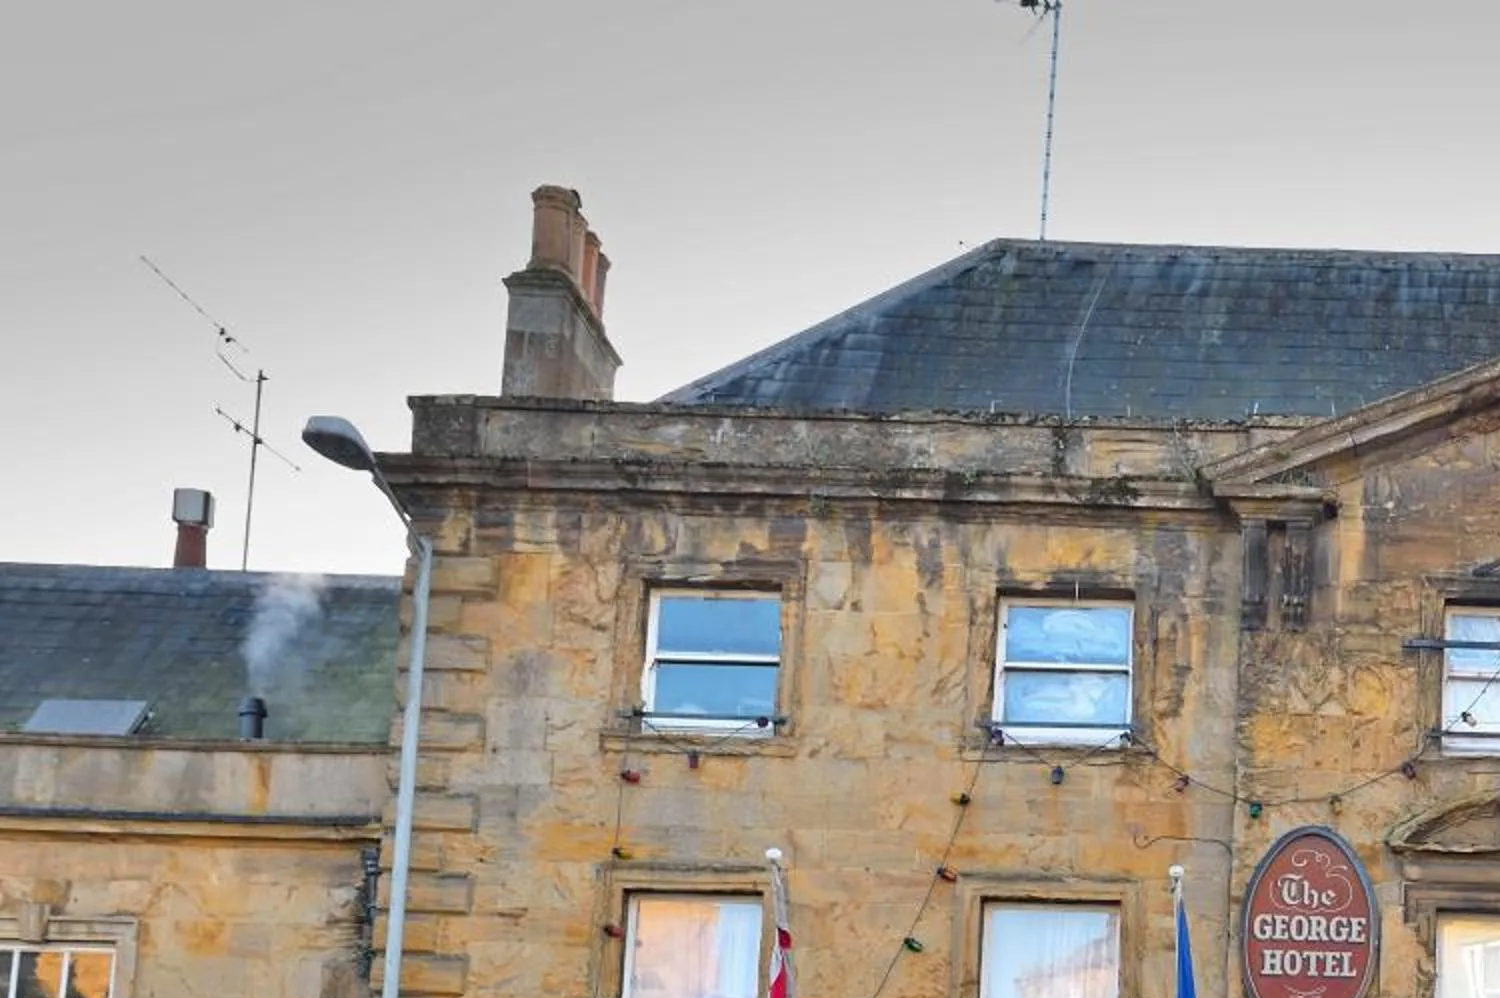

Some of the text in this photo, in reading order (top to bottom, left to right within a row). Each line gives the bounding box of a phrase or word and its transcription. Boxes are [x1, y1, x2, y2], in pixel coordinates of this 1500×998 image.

[1277, 873, 1336, 909] The
[1253, 913, 1367, 942] GEORGE
[1260, 949, 1357, 977] HOTEL
